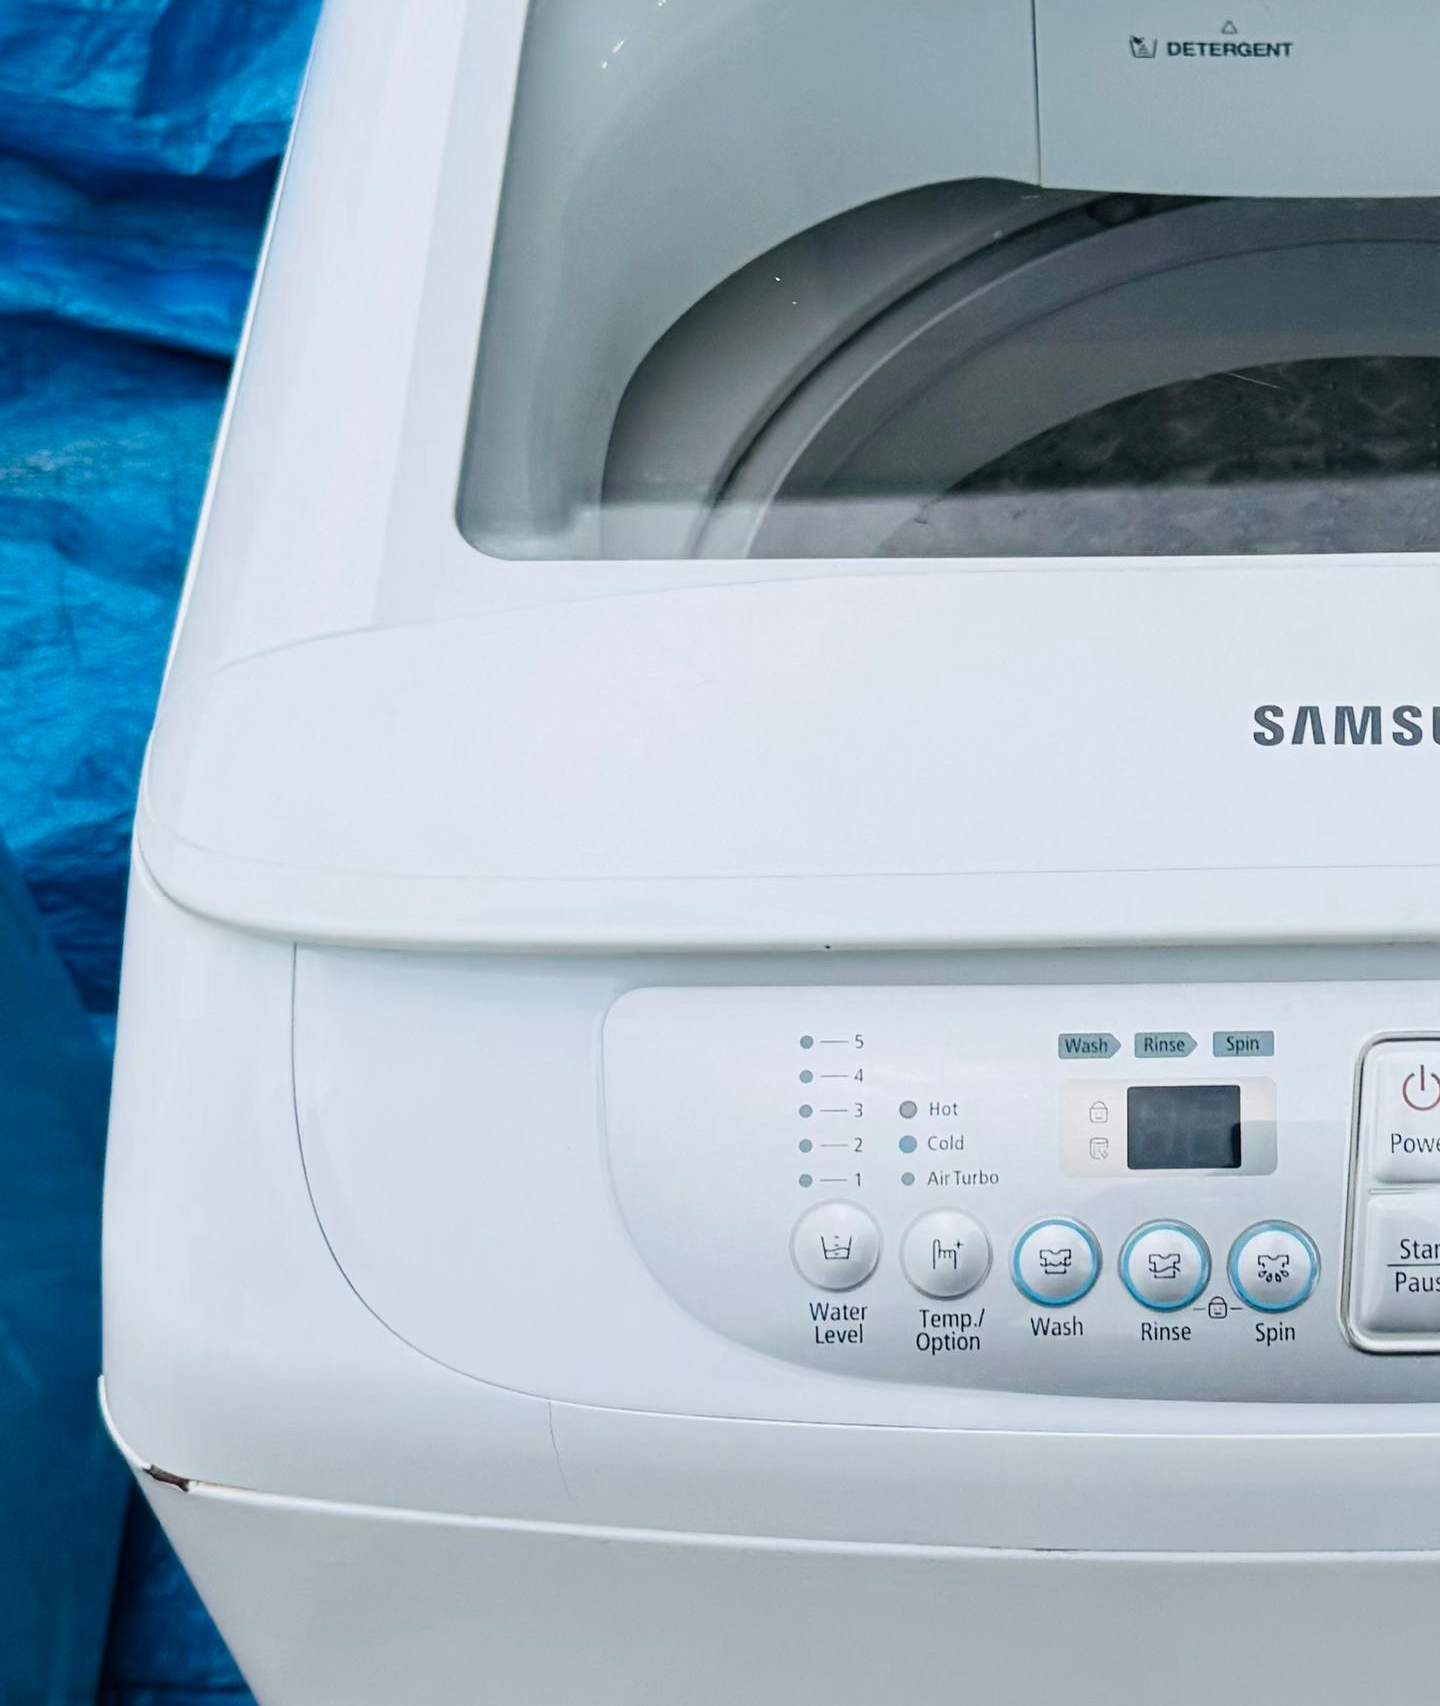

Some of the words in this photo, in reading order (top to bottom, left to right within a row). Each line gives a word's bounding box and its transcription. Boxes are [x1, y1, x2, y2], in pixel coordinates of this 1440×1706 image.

[1166, 41, 1293, 58] DETERGENT
[855, 1034, 865, 1049] 5
[1064, 1037, 1108, 1054] Wash
[1144, 1036, 1185, 1053] Rinse
[1226, 1035, 1260, 1056] Spin
[853, 1068, 864, 1083] 4
[854, 1102, 864, 1118] 3
[929, 1101, 958, 1117] Hot
[854, 1137, 863, 1153] 2
[927, 1134, 964, 1151] Cold
[855, 1172, 861, 1187] 1
[927, 1171, 951, 1186] Air
[953, 1169, 1000, 1186] Turbo
[809, 1302, 868, 1322] Water
[919, 1308, 985, 1332] Temp./
[815, 1323, 863, 1345] Level
[1030, 1315, 1084, 1337] Wash
[1141, 1321, 1192, 1342] Rinse
[1255, 1321, 1296, 1347] Spin
[916, 1331, 981, 1356] Option
